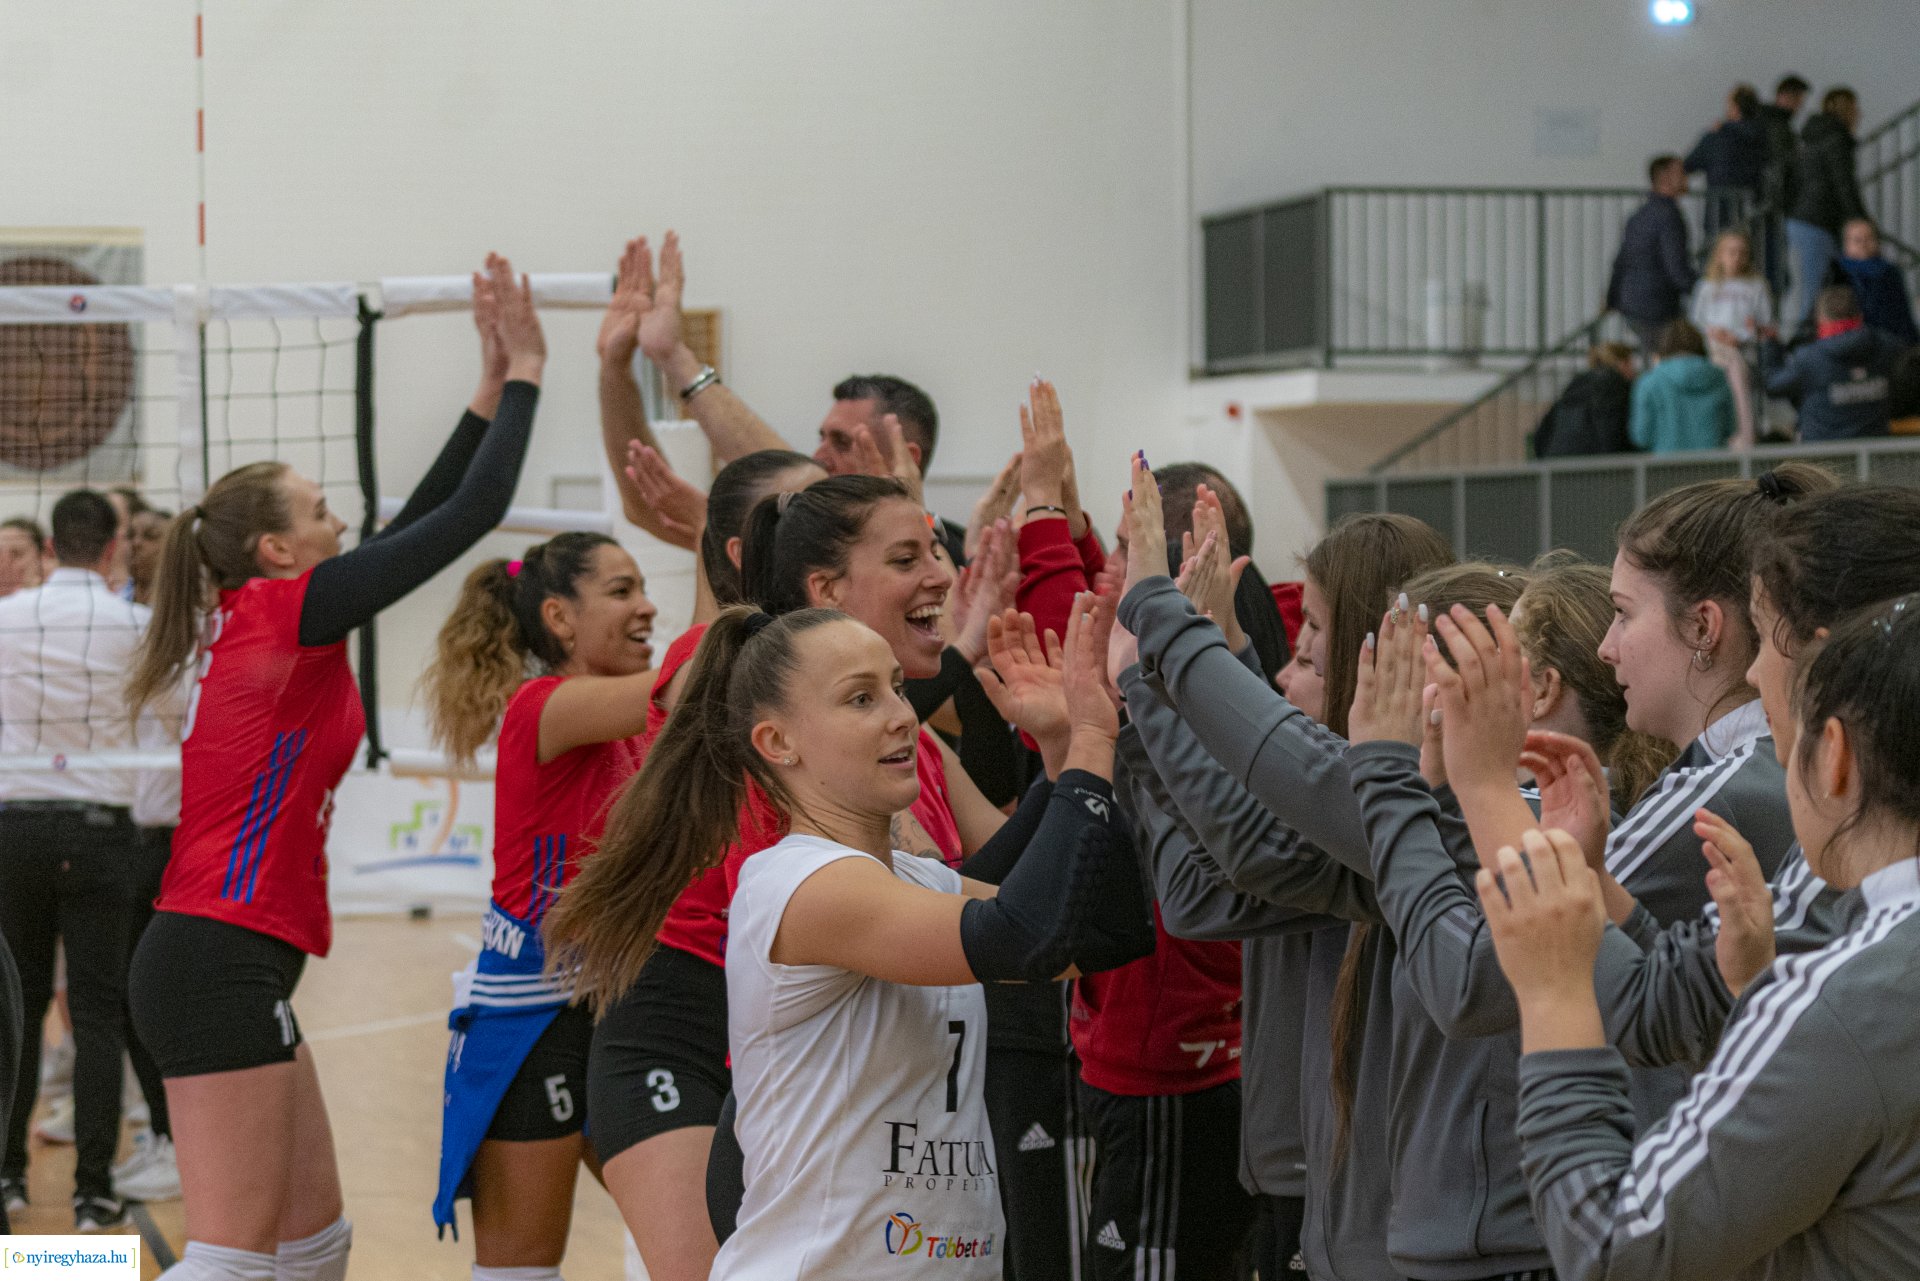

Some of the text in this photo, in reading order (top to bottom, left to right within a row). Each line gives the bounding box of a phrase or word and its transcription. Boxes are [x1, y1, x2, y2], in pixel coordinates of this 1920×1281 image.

[946, 1020, 965, 1112] 7
[544, 1073, 574, 1122] 5
[646, 1068, 681, 1113] 3
[1018, 1137, 1056, 1152] adidas
[927, 1235, 978, 1258] Többet
